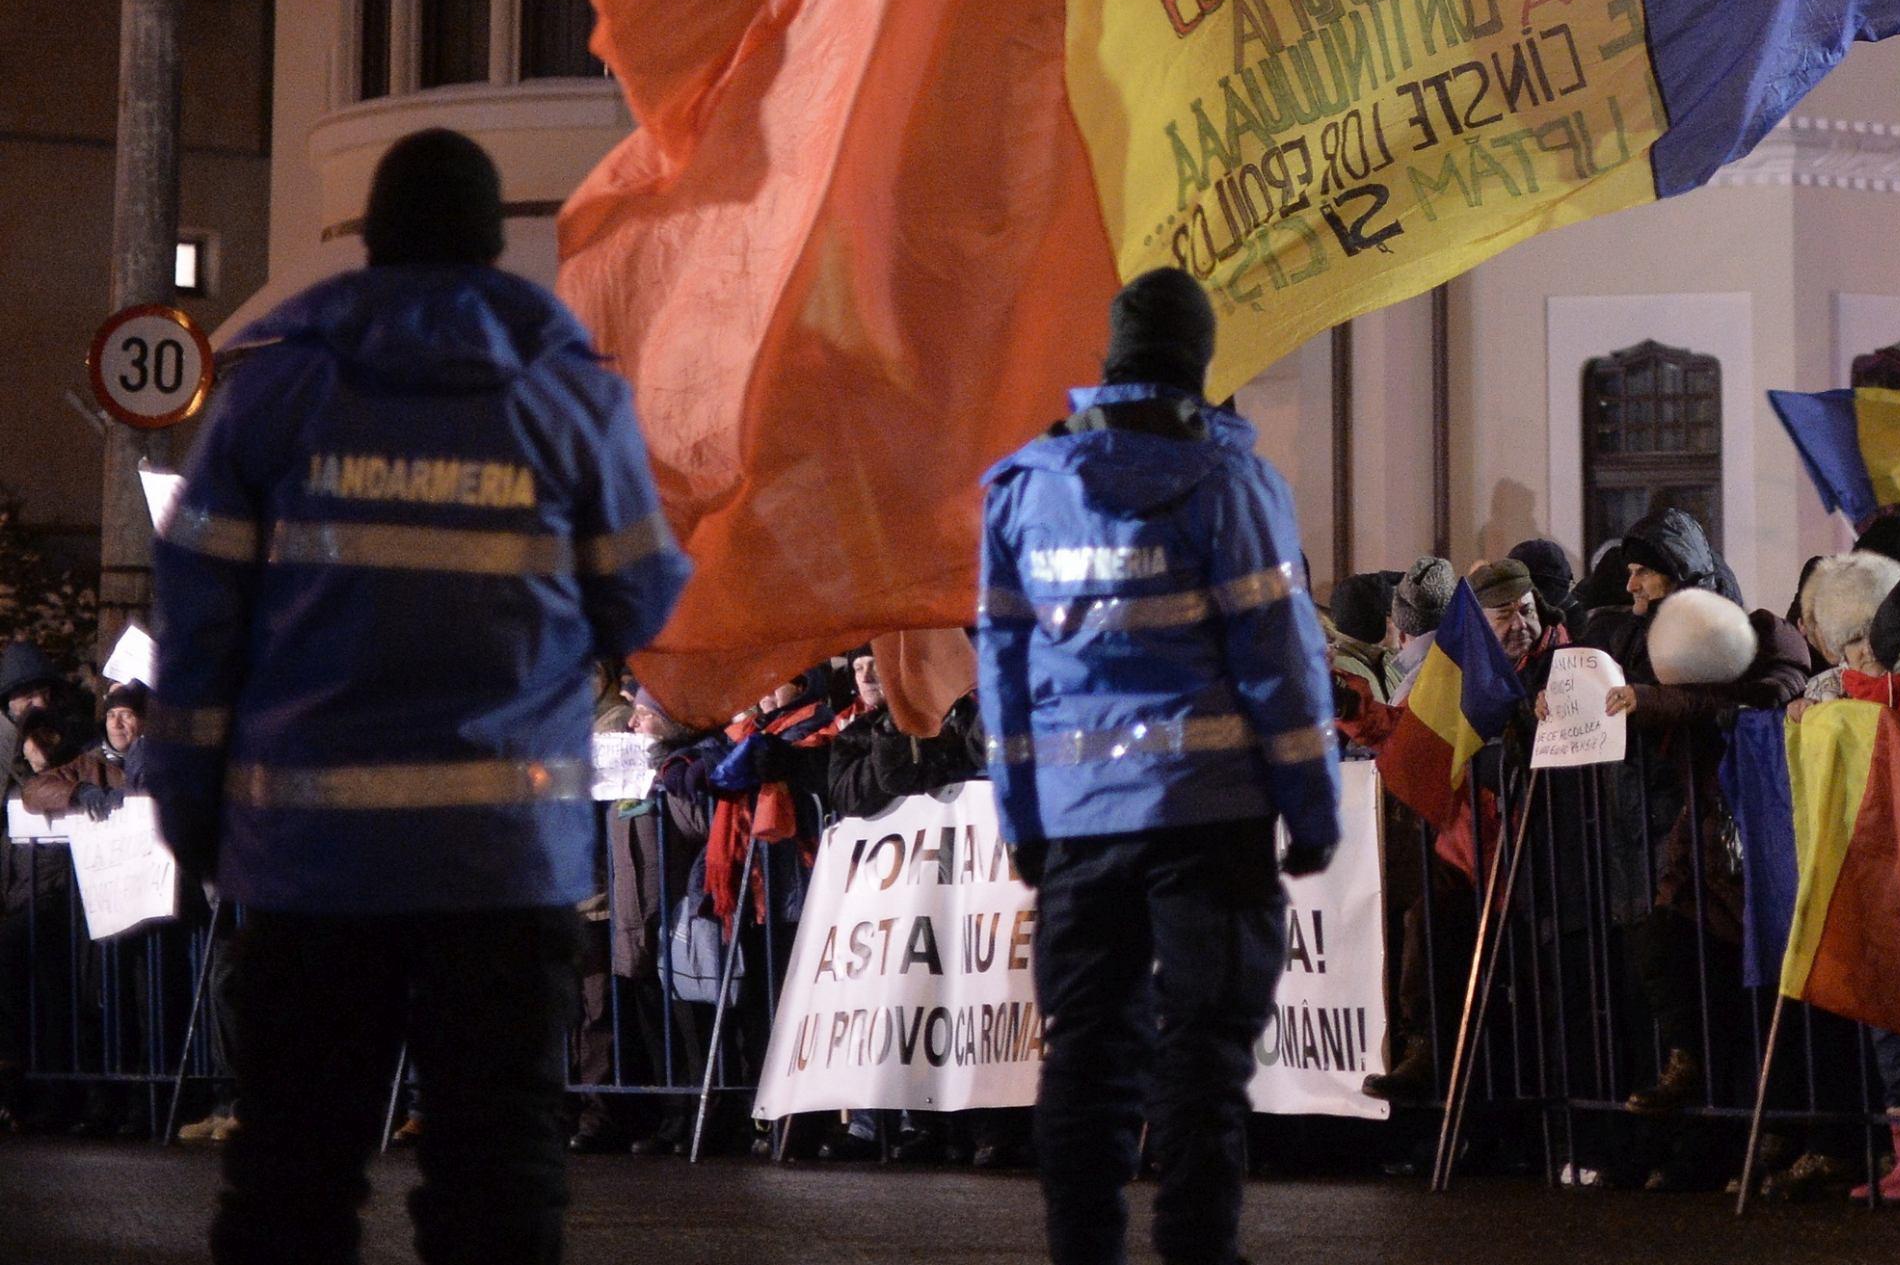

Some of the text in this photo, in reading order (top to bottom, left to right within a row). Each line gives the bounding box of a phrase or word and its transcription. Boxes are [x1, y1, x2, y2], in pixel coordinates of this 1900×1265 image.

[120, 337, 184, 393] 30
[814, 915, 943, 984] ASTA
[961, 913, 1002, 975] NU
[1254, 998, 1367, 1072] OMÂNI!
